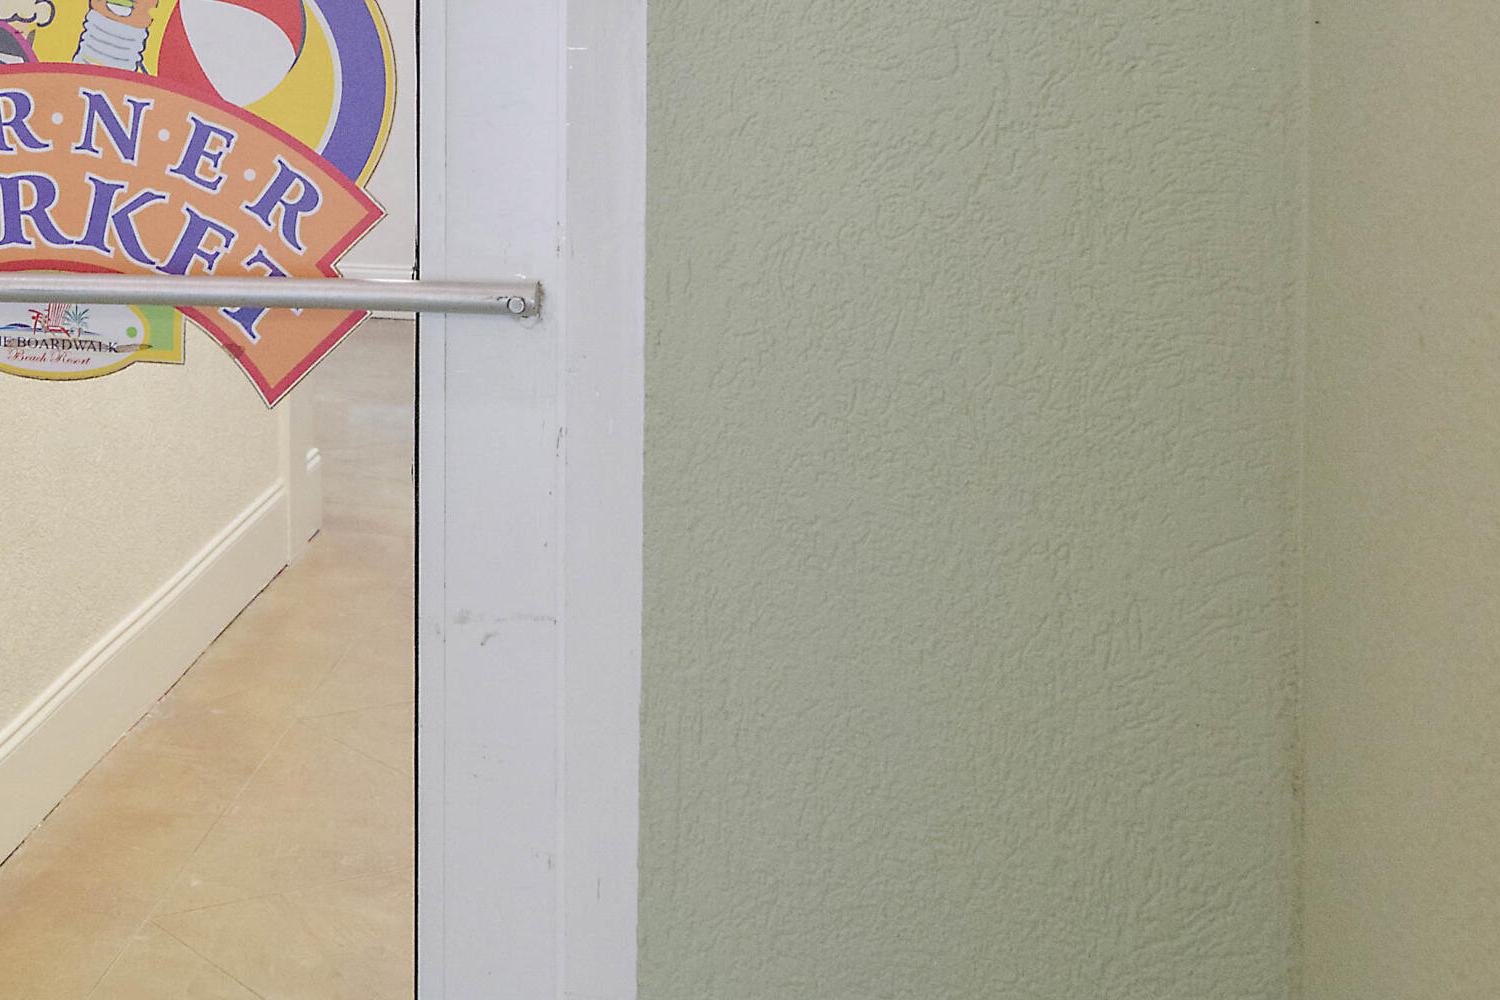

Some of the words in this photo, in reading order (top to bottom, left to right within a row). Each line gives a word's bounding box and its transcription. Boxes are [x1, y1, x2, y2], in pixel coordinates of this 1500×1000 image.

[17, 336, 118, 353] BOARDWALK
[7, 349, 46, 362] Beach
[50, 350, 90, 365] Resort
